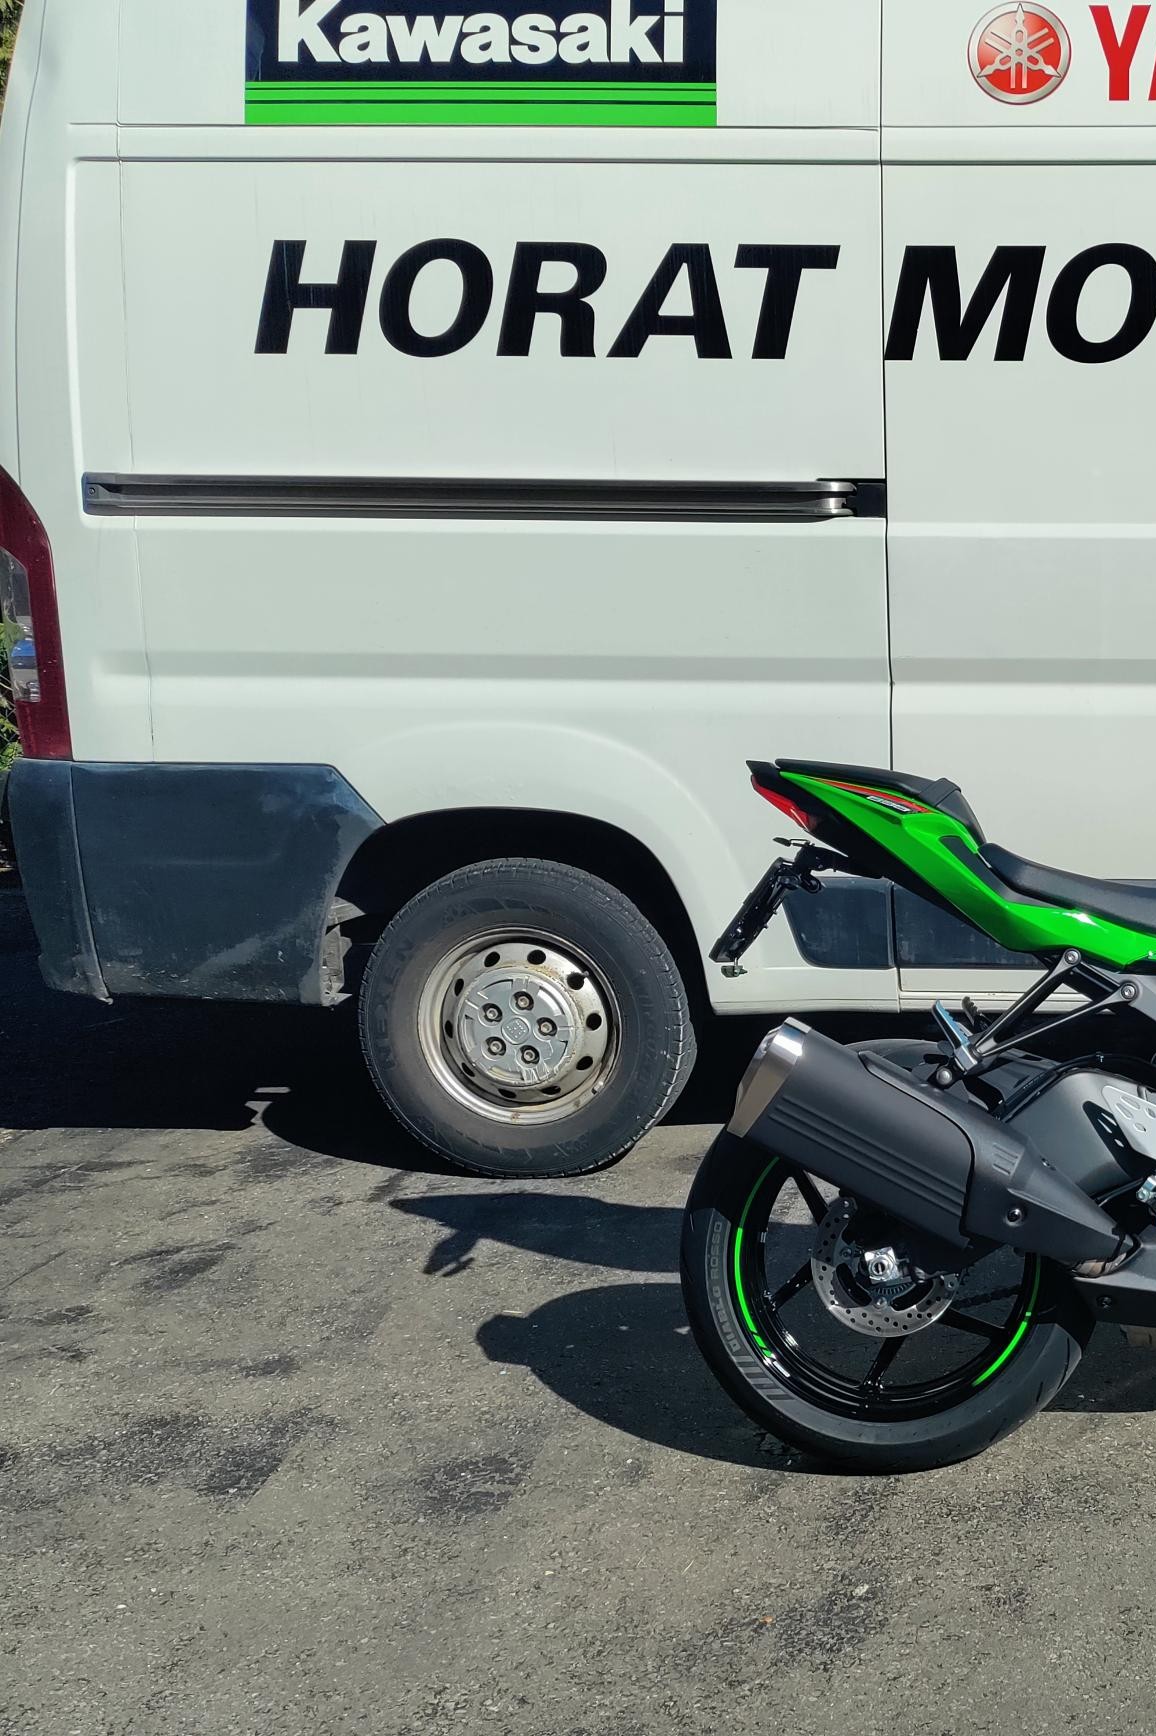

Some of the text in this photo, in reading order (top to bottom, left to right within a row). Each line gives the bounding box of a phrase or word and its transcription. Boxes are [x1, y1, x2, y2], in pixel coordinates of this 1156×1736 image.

[278, 0, 685, 66] Kawasaki
[255, 239, 841, 361] HORAT
[709, 1220, 742, 1354] DIABLO ROSSO
